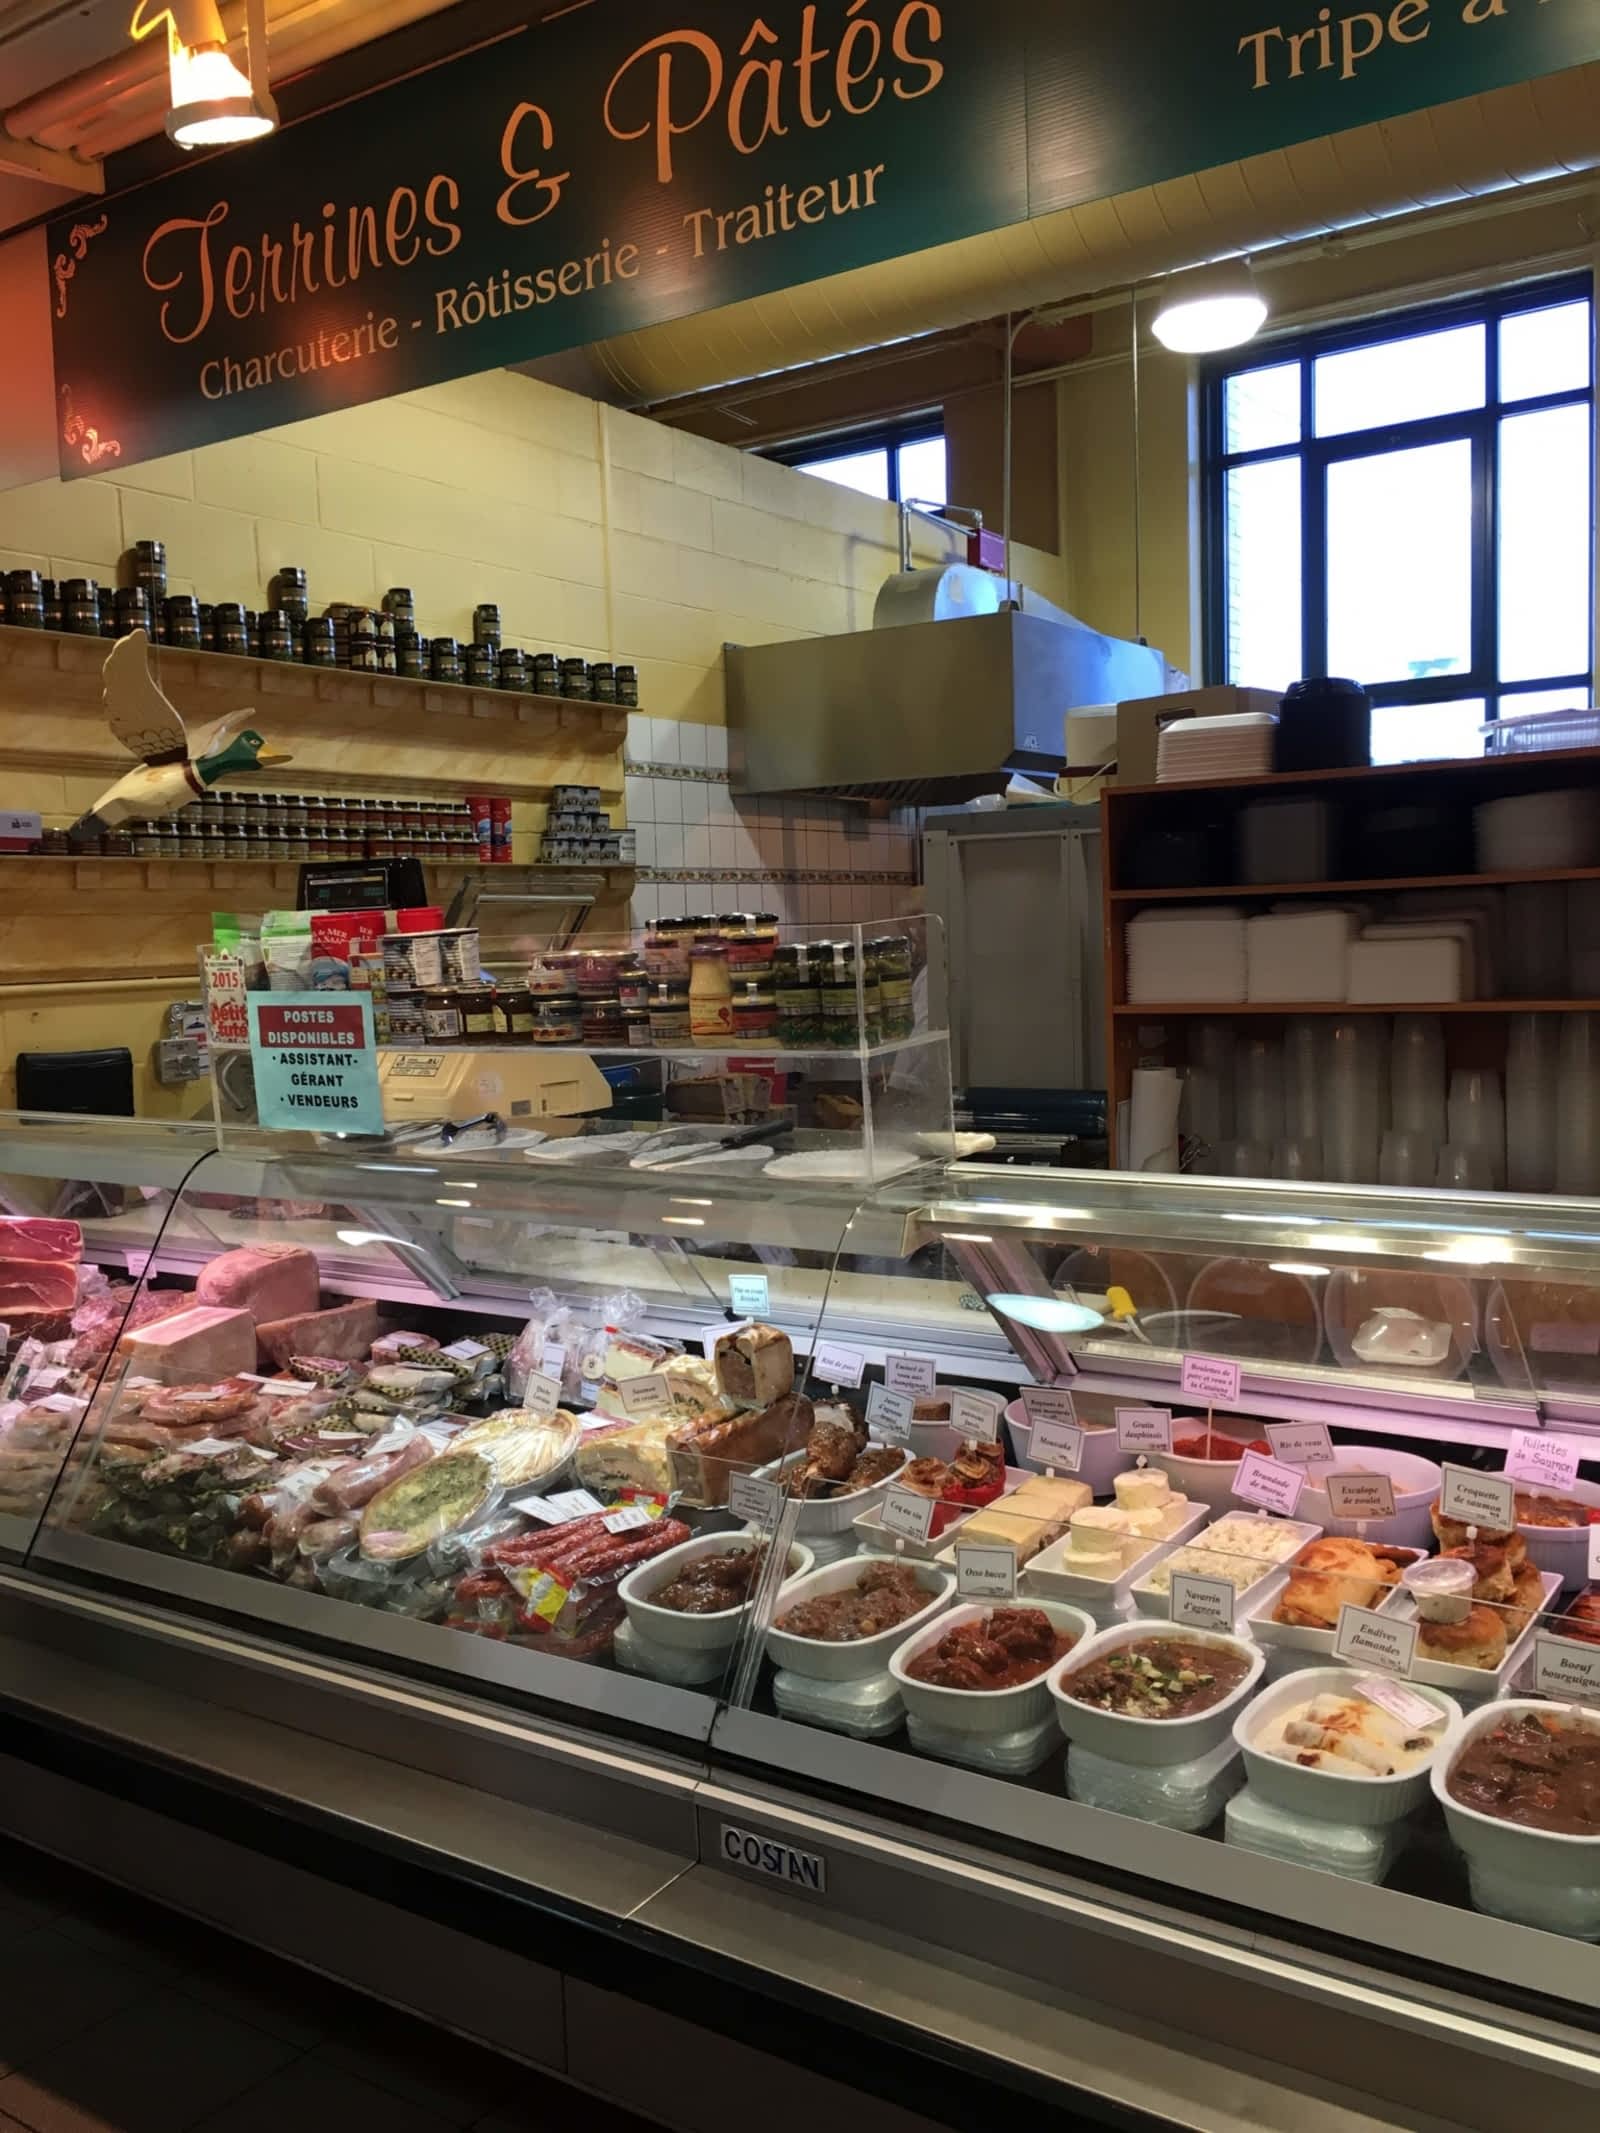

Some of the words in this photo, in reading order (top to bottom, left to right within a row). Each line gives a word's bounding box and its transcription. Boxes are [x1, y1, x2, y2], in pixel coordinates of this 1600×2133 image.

[1237, 0, 1431, 89] Tripe
[143, 174, 461, 343] Terrines
[496, 102, 570, 226] &
[603, 0, 944, 183] Pâtés
[200, 311, 399, 400] Charcuterie
[435, 237, 640, 334] Rôtisserie
[682, 164, 886, 257] Traiteur
[212, 972, 239, 988] 2015
[283, 1010, 335, 1023] POSTES
[268, 1031, 355, 1045] DISPONIBLES
[280, 1052, 358, 1066] ASSISTANT-
[291, 1072, 344, 1087] GÉRANT
[288, 1094, 359, 1108] VENDEURS
[1132, 1420, 1155, 1429] Gratin
[1125, 1430, 1162, 1440] dauphinois
[1523, 1436, 1568, 1457] Rillettes
[1515, 1450, 1526, 1460] de
[1532, 1452, 1573, 1473] Saumon
[1252, 1469, 1290, 1488] Brandade
[1250, 1480, 1260, 1488] de
[1260, 1485, 1287, 1498] morue
[1342, 1486, 1378, 1496] Escalope
[1457, 1483, 1500, 1501] Croquette
[1343, 1496, 1352, 1504] de
[1354, 1496, 1381, 1505] poulet
[1454, 1495, 1464, 1503] de
[1466, 1499, 1502, 1512] saumon
[890, 1501, 902, 1513] Coq
[912, 1508, 922, 1520] vin
[965, 1567, 983, 1577] Osso
[1360, 1623, 1397, 1642] Endives
[1350, 1634, 1400, 1656] flamandes
[1560, 1658, 1595, 1675] Boeuf
[724, 1830, 819, 1889] COSTAN
